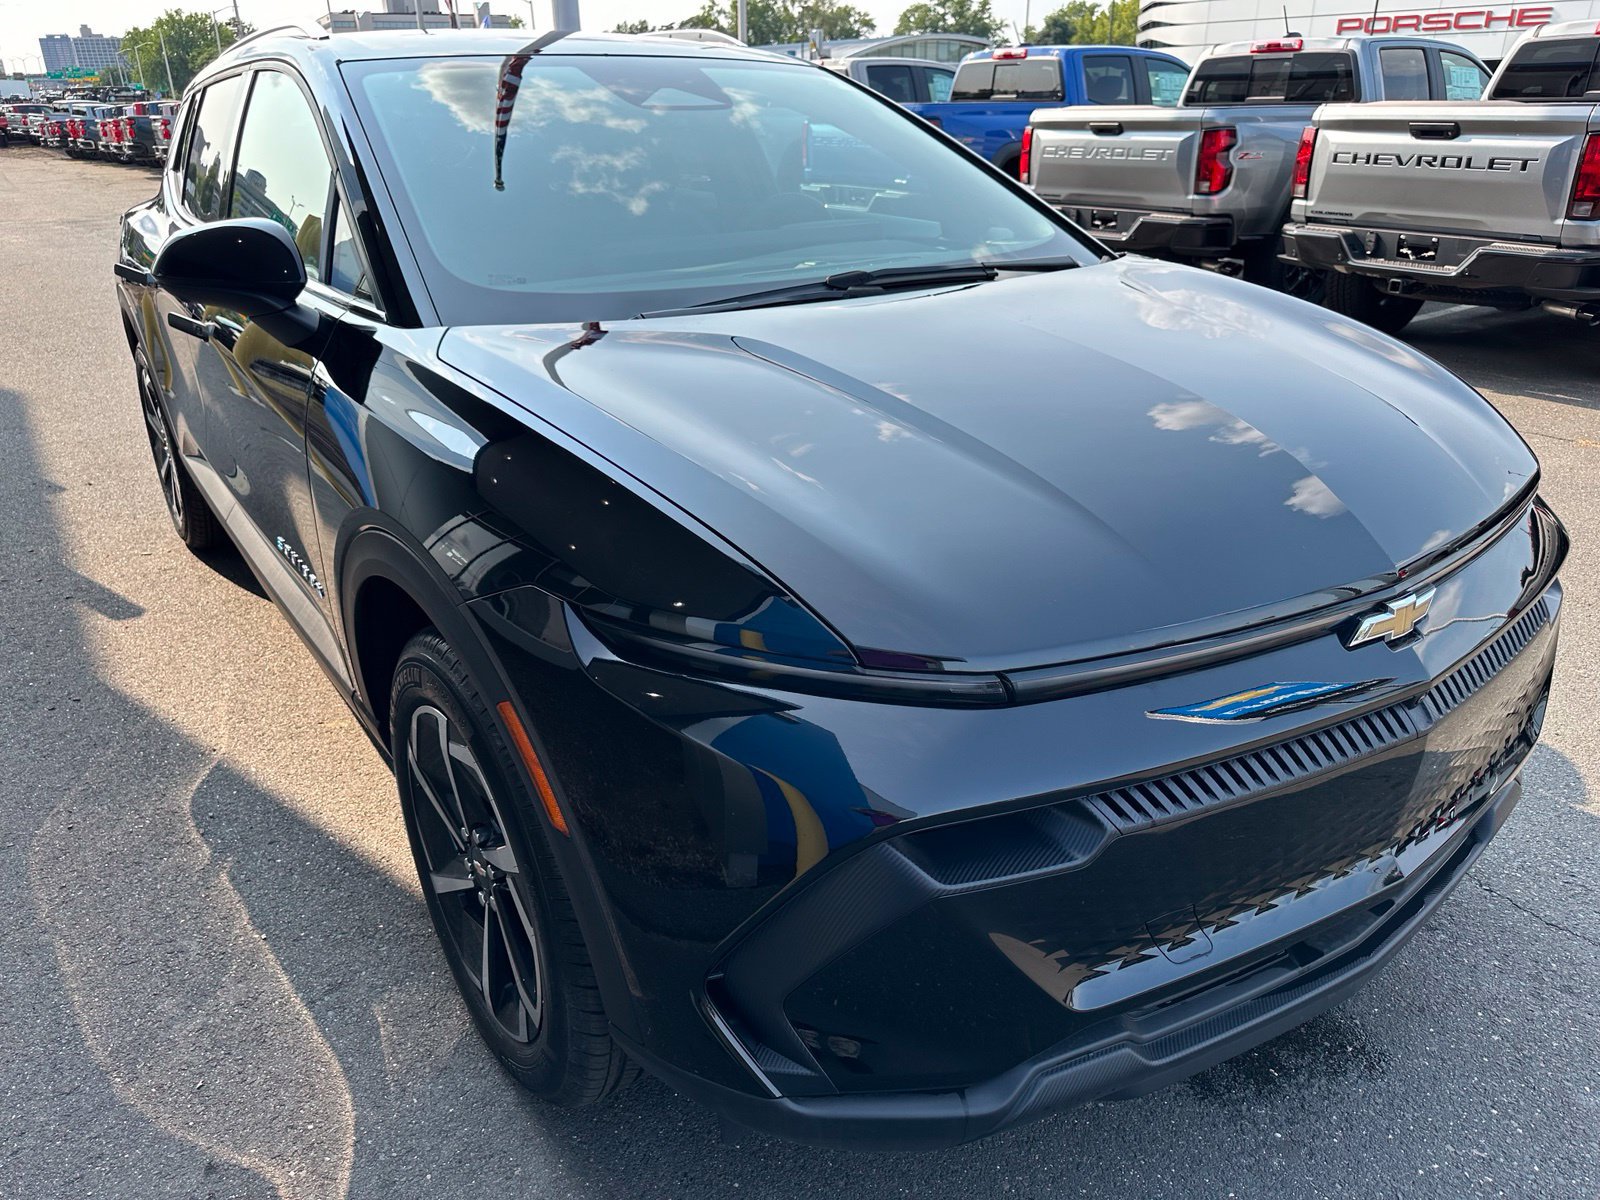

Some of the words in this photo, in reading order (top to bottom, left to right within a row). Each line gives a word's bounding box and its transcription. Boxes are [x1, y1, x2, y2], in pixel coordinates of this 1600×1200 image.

[1336, 7, 1554, 36] PORSCHE
[1042, 145, 1175, 161] CHEVROLET
[1331, 151, 1540, 173] CHEVROLET
